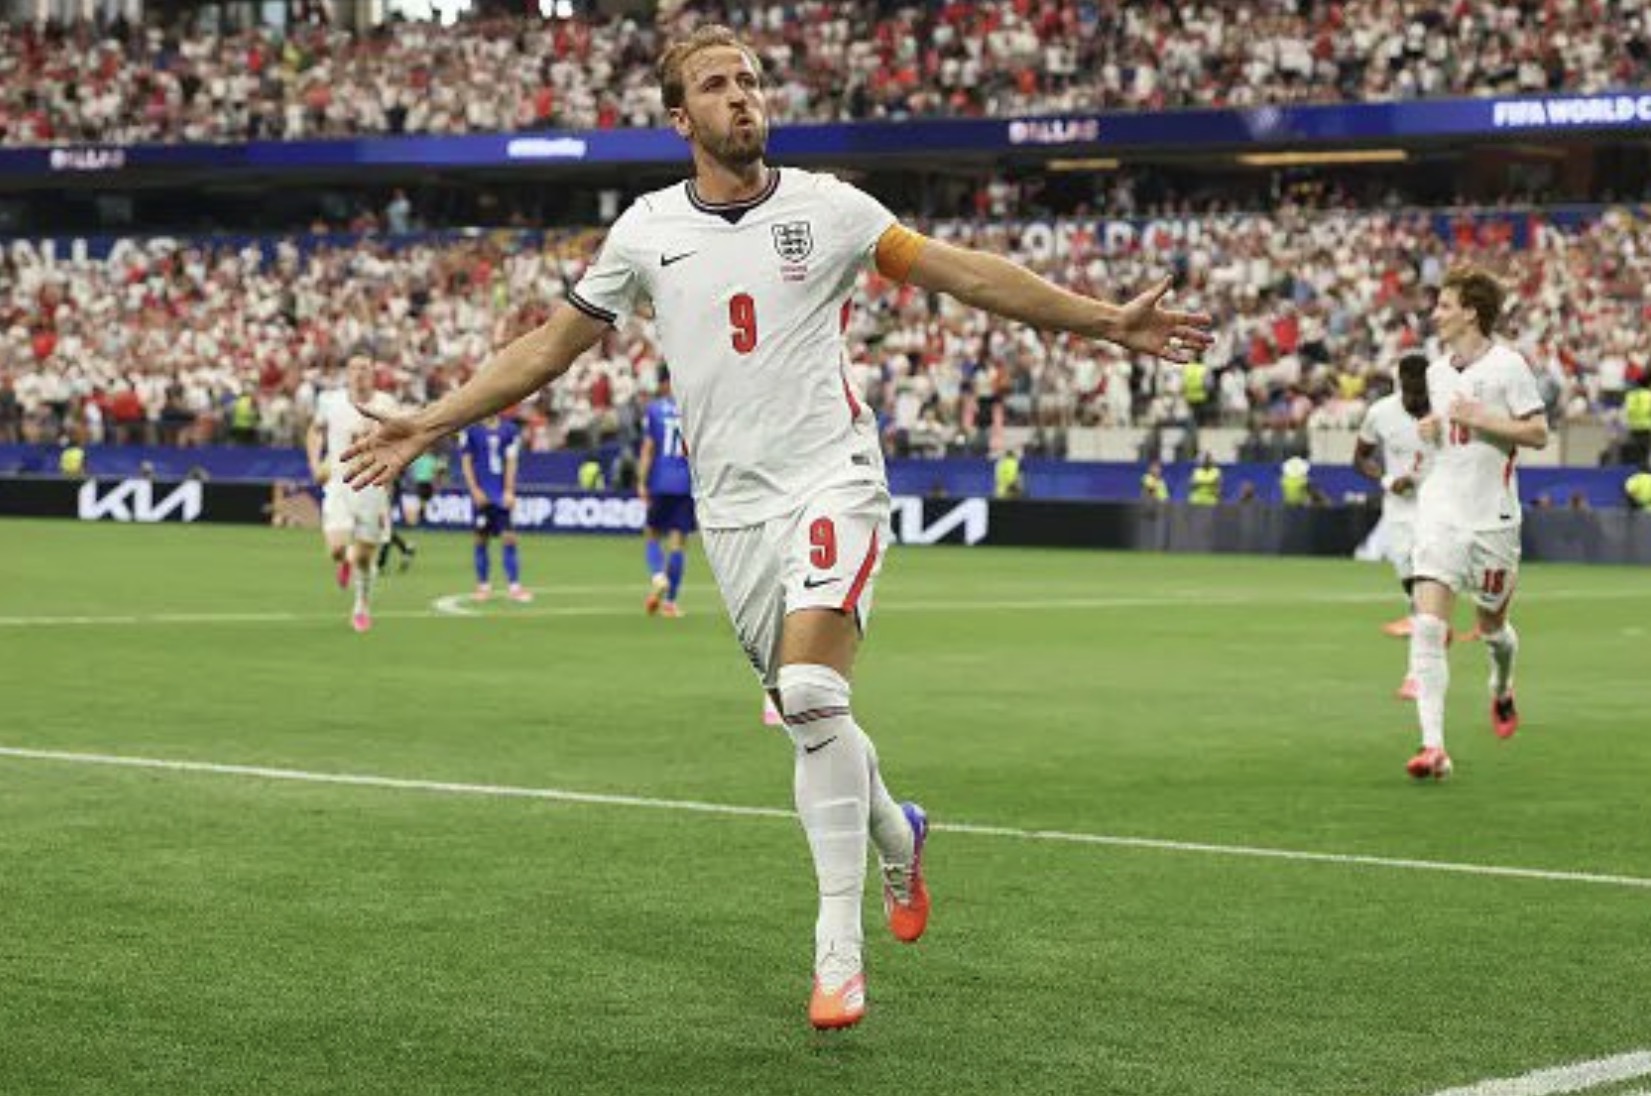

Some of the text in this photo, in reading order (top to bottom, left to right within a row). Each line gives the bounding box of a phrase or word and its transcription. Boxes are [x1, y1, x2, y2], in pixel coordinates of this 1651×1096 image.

[1494, 101, 1546, 127] FIFA
[1546, 96, 1636, 124] WORLD
[729, 293, 758, 355] 9
[553, 497, 647, 528] 2026
[810, 516, 837, 570] 9
